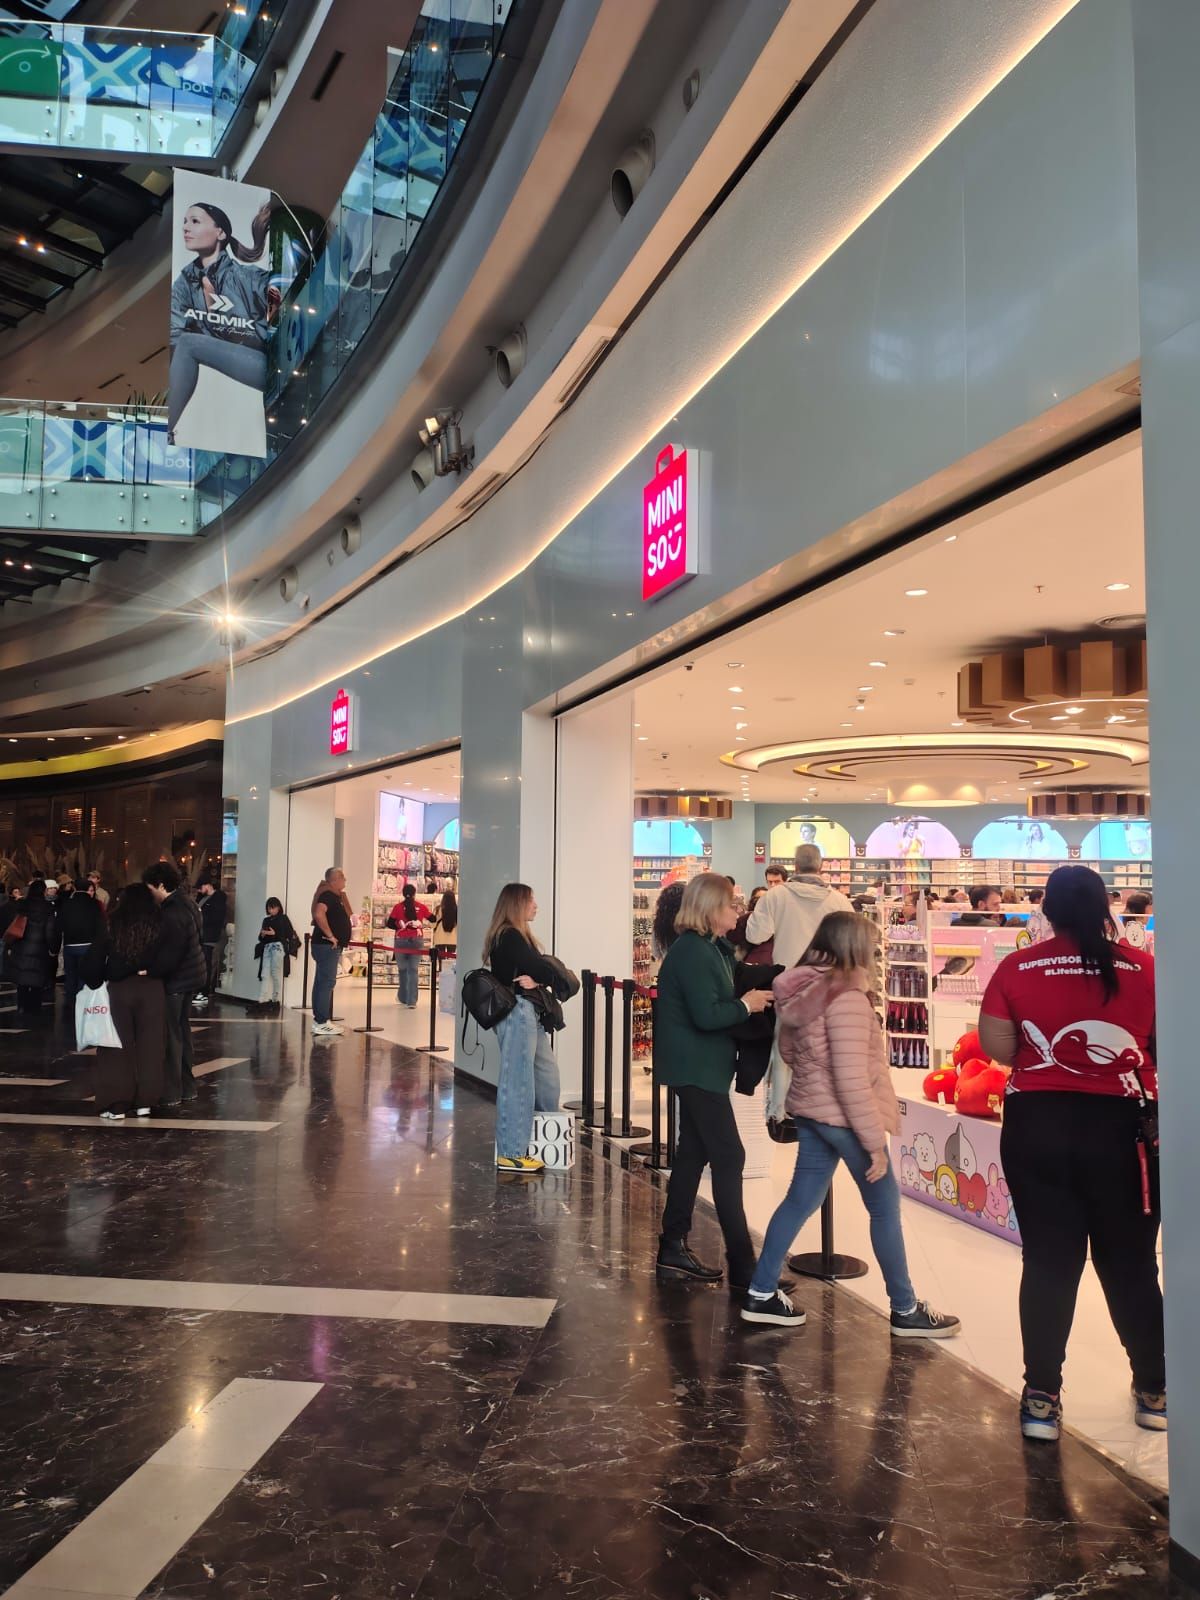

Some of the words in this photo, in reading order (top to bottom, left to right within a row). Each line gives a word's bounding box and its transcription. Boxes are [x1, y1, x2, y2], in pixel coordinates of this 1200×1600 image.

[184, 308, 256, 330] ATOMIK
[647, 474, 683, 535] MINI
[333, 705, 347, 726] MINI
[1018, 955, 1082, 971] SUPERVISOR
